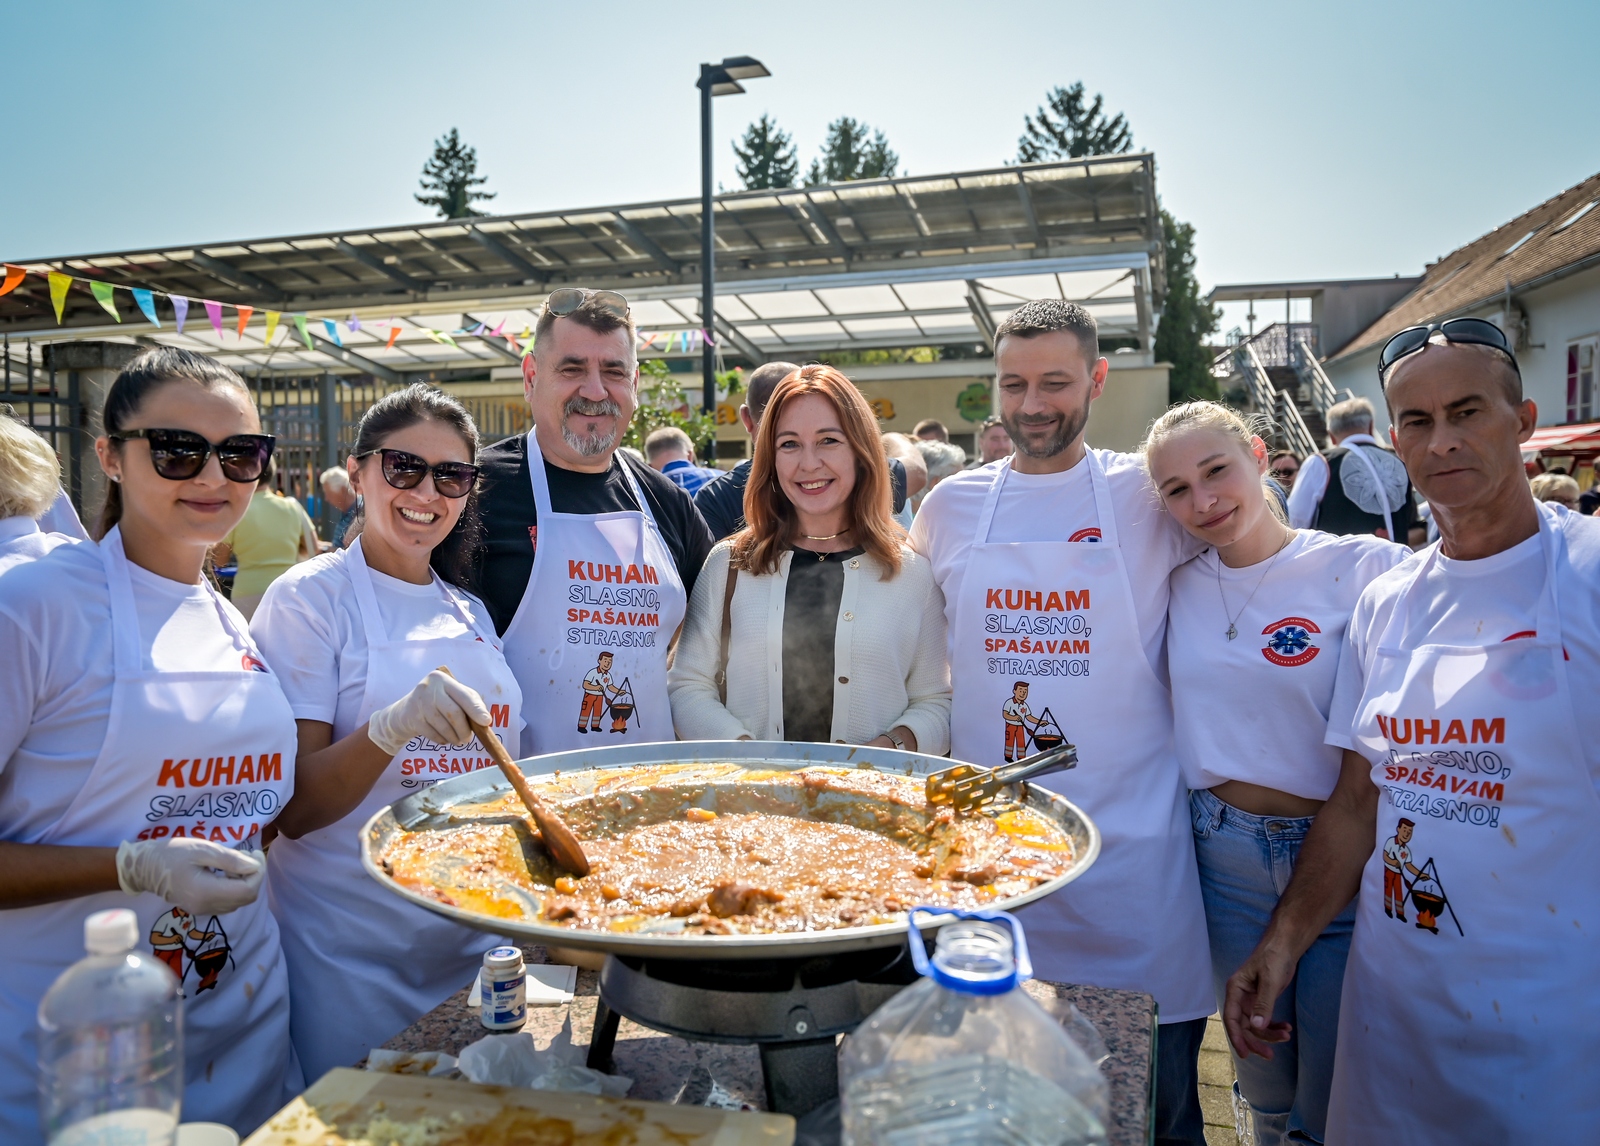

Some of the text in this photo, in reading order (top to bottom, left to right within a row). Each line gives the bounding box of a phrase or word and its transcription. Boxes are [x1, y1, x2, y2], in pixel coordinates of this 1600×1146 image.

[568, 560, 659, 585] KUHAM
[568, 584, 660, 611] SLASNO,
[985, 588, 1090, 612] KUHAM
[567, 608, 659, 627] SPAŠAVAM
[985, 614, 1092, 638] SLASNO,
[984, 636, 1090, 654] SPAŠAVAM
[987, 657, 1090, 676] STRASNO!
[156, 753, 282, 788] KUHAM
[1385, 766, 1504, 802] SPAŠAVAM
[145, 789, 281, 822] SLASNO
[1383, 785, 1500, 828] TRASNO!
[137, 821, 262, 843] SPAŠAVA
